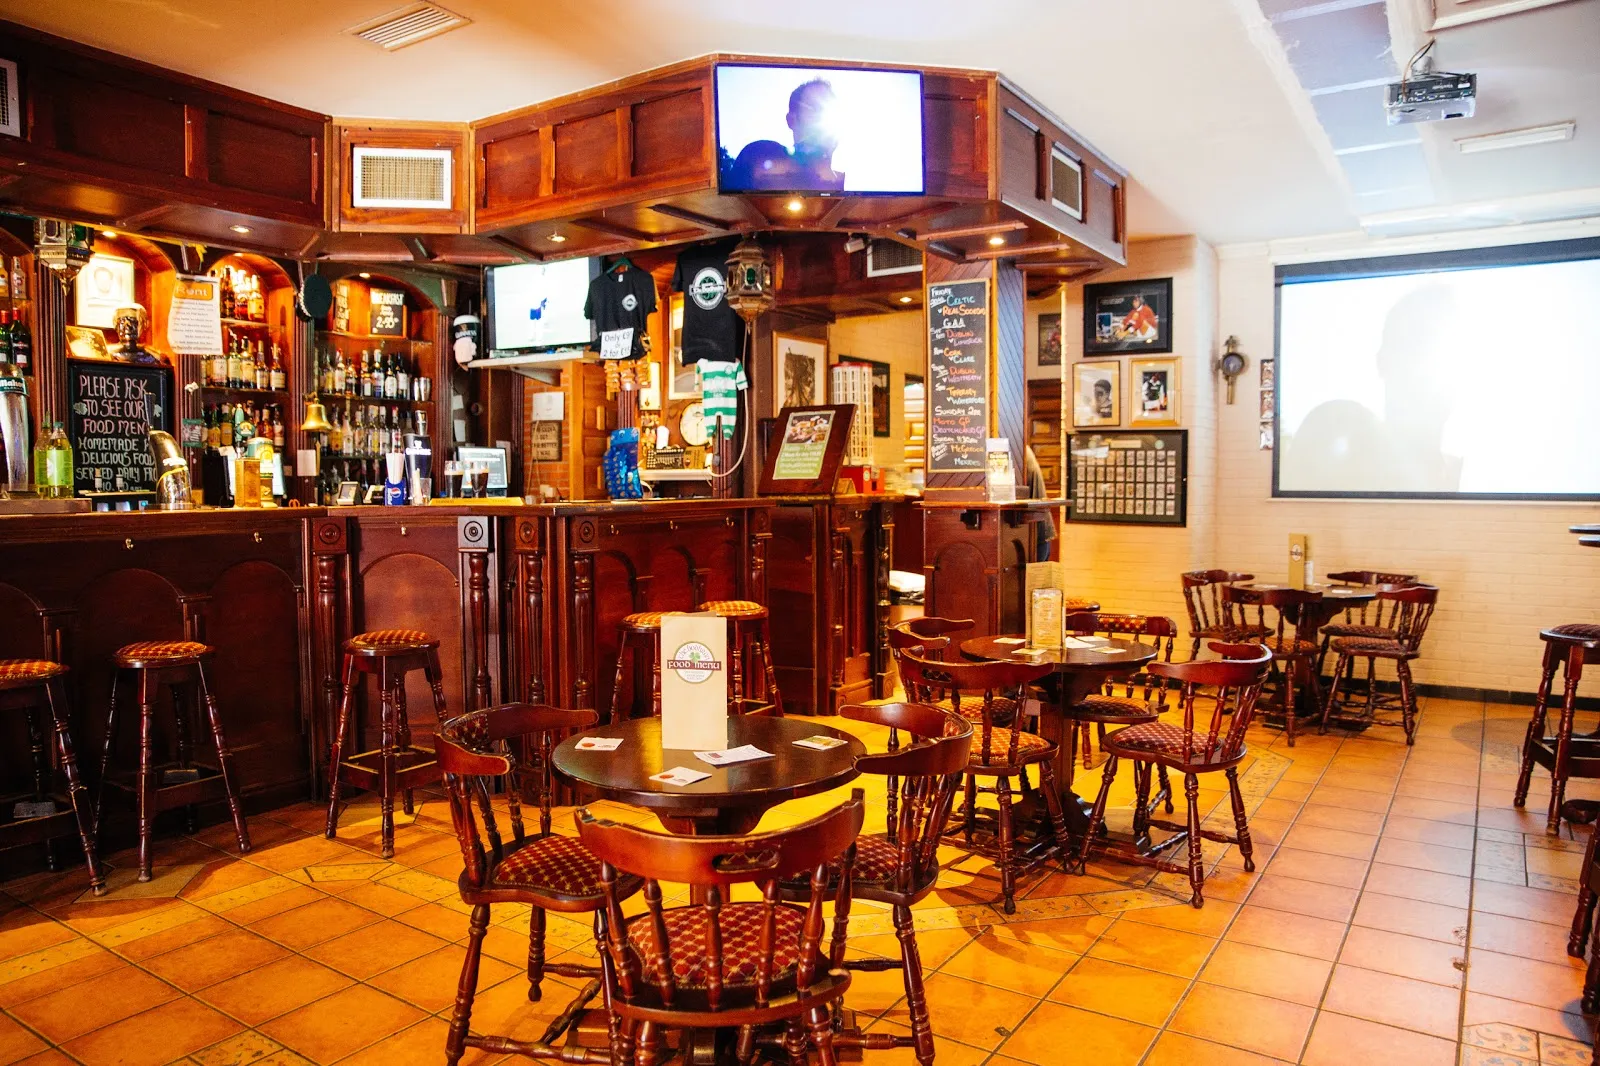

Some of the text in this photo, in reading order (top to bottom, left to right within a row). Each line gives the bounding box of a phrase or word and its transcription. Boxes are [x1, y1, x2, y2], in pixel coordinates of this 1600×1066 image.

[942, 318, 966, 328] GAA
[80, 375, 148, 400] PLEASE ASK
[83, 399, 148, 420] TO SEE OUR
[934, 405, 966, 416] SUNDAY
[83, 419, 115, 434] FOOD
[78, 437, 139, 452] HOMEMADE
[81, 451, 132, 467] DELICIOUS
[76, 467, 114, 480] SERED
